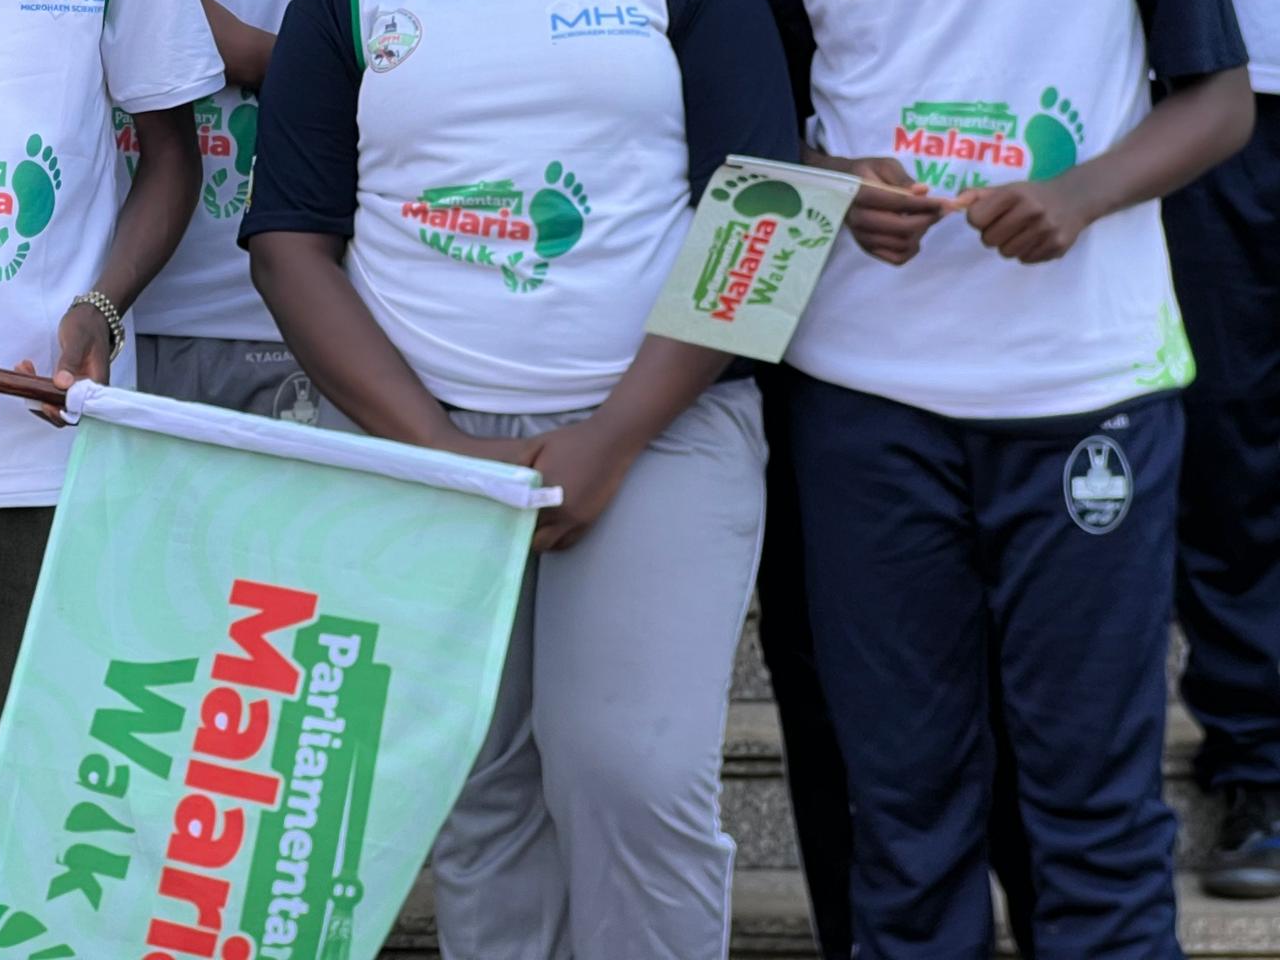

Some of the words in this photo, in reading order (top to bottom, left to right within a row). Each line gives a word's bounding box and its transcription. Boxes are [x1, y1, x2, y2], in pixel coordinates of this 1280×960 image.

[21, 3, 70, 12] MICROHAEM
[551, 6, 650, 31] MHS
[894, 127, 1024, 168] Malaria
[402, 202, 531, 241] Malaria
[710, 220, 779, 322] Malaria
[746, 248, 797, 305] Walk
[45, 655, 200, 912] Walk
[142, 578, 319, 960] Malari
[260, 632, 362, 960] Parliamentar
